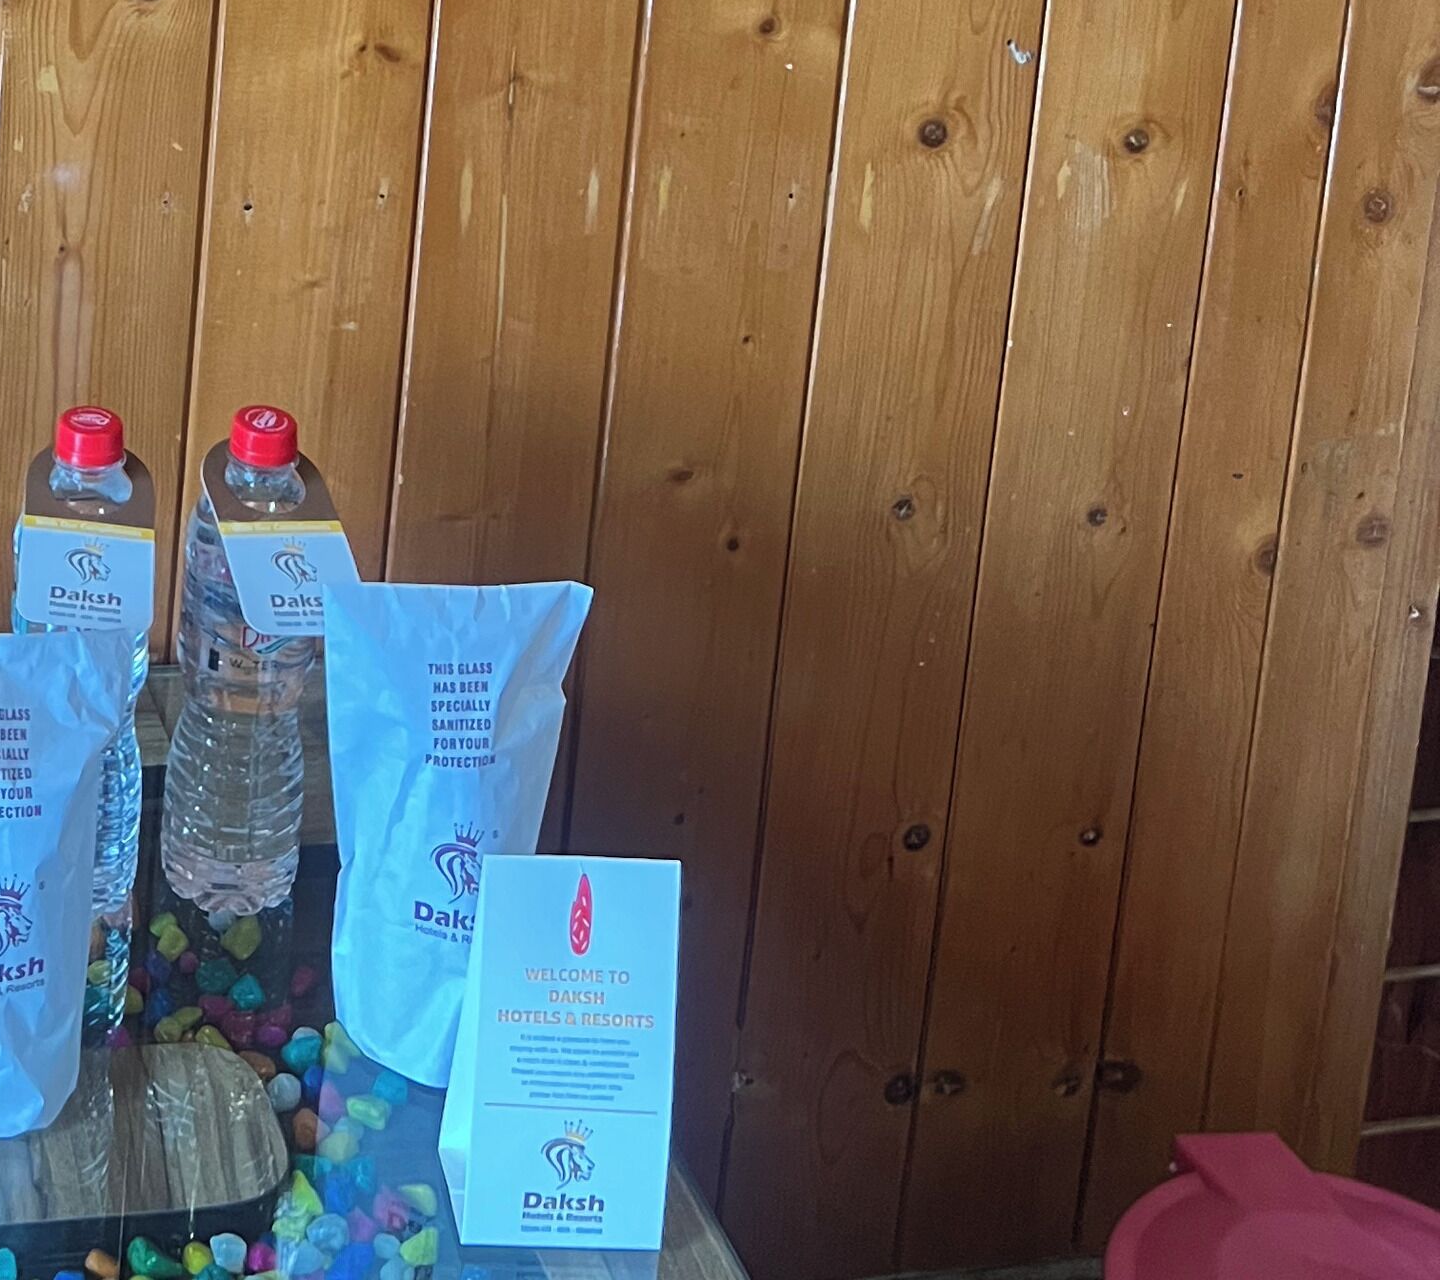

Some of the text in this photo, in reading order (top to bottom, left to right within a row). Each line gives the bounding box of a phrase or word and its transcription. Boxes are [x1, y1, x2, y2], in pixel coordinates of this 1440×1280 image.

[49, 586, 122, 606] Daksh
[270, 594, 323, 608] Daks
[427, 662, 493, 675] THIS GLASS
[433, 681, 489, 693] HAS BEEN
[431, 700, 491, 712] SPECIALLY
[432, 719, 492, 731] SANITIZED
[0, 728, 28, 740] BEEN
[433, 738, 490, 750] FOR YOUR
[425, 754, 497, 768] PROTECTION
[0, 786, 33, 800] YOUR
[525, 968, 631, 985] WELCOME TO
[549, 990, 605, 1005] DAKSH
[497, 1009, 655, 1029] HOTELS & RESORTS
[523, 1192, 605, 1212] Daksh
